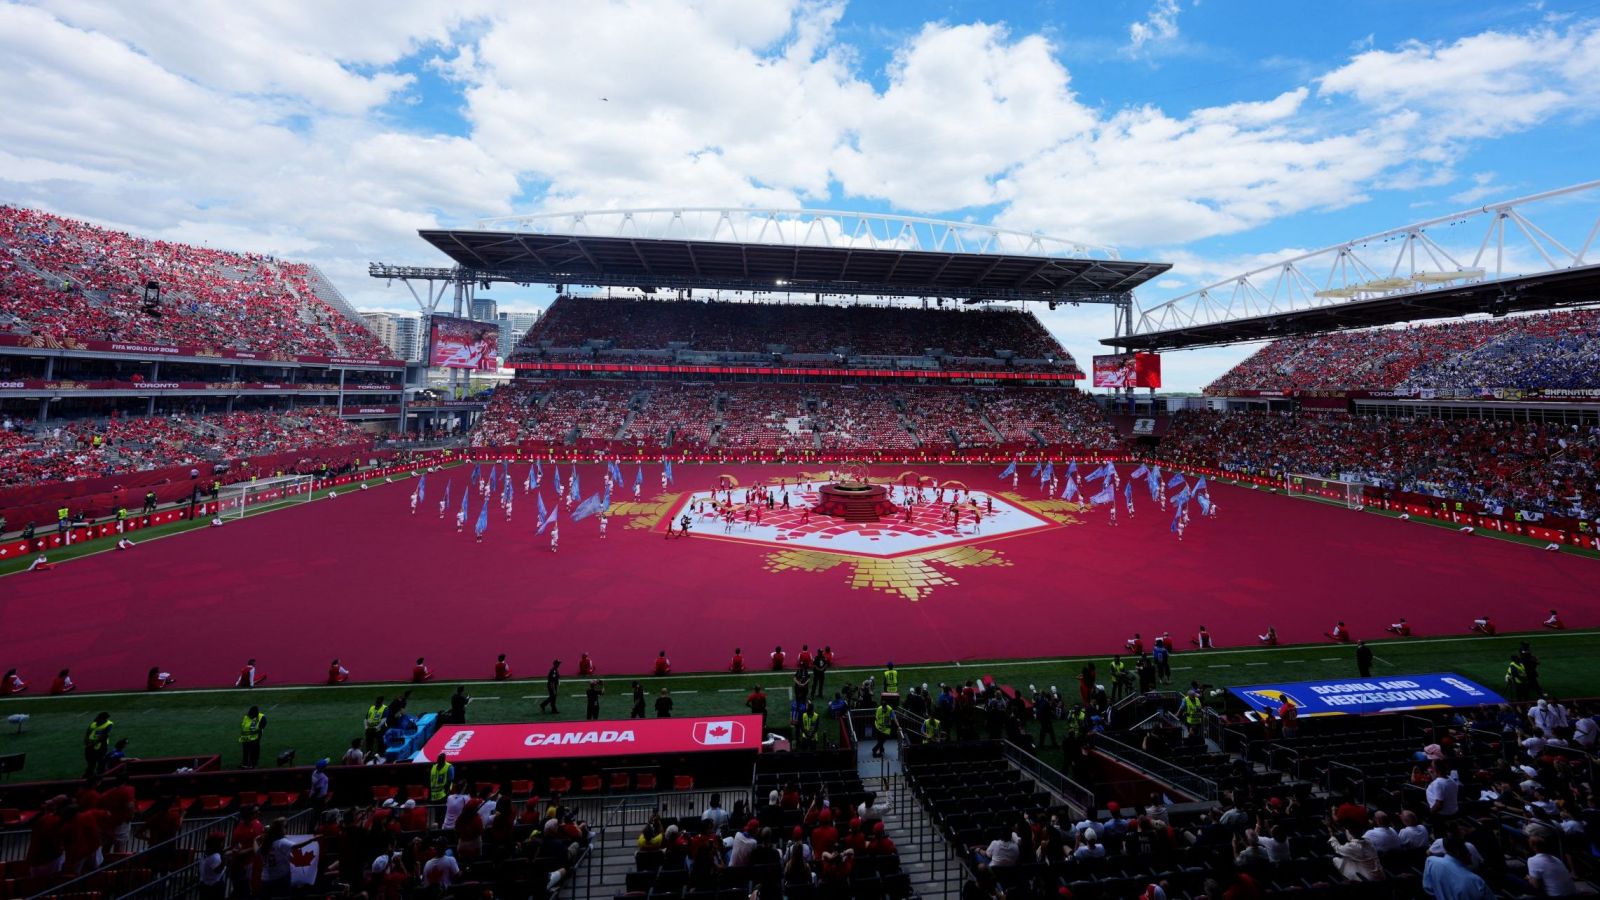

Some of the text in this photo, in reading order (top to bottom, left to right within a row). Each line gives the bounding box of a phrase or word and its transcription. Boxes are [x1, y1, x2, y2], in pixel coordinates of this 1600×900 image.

[1309, 680, 1420, 694] BOSNIA AND
[1318, 688, 1451, 706] HERZEGOVINA
[524, 730, 635, 746] CANADA
